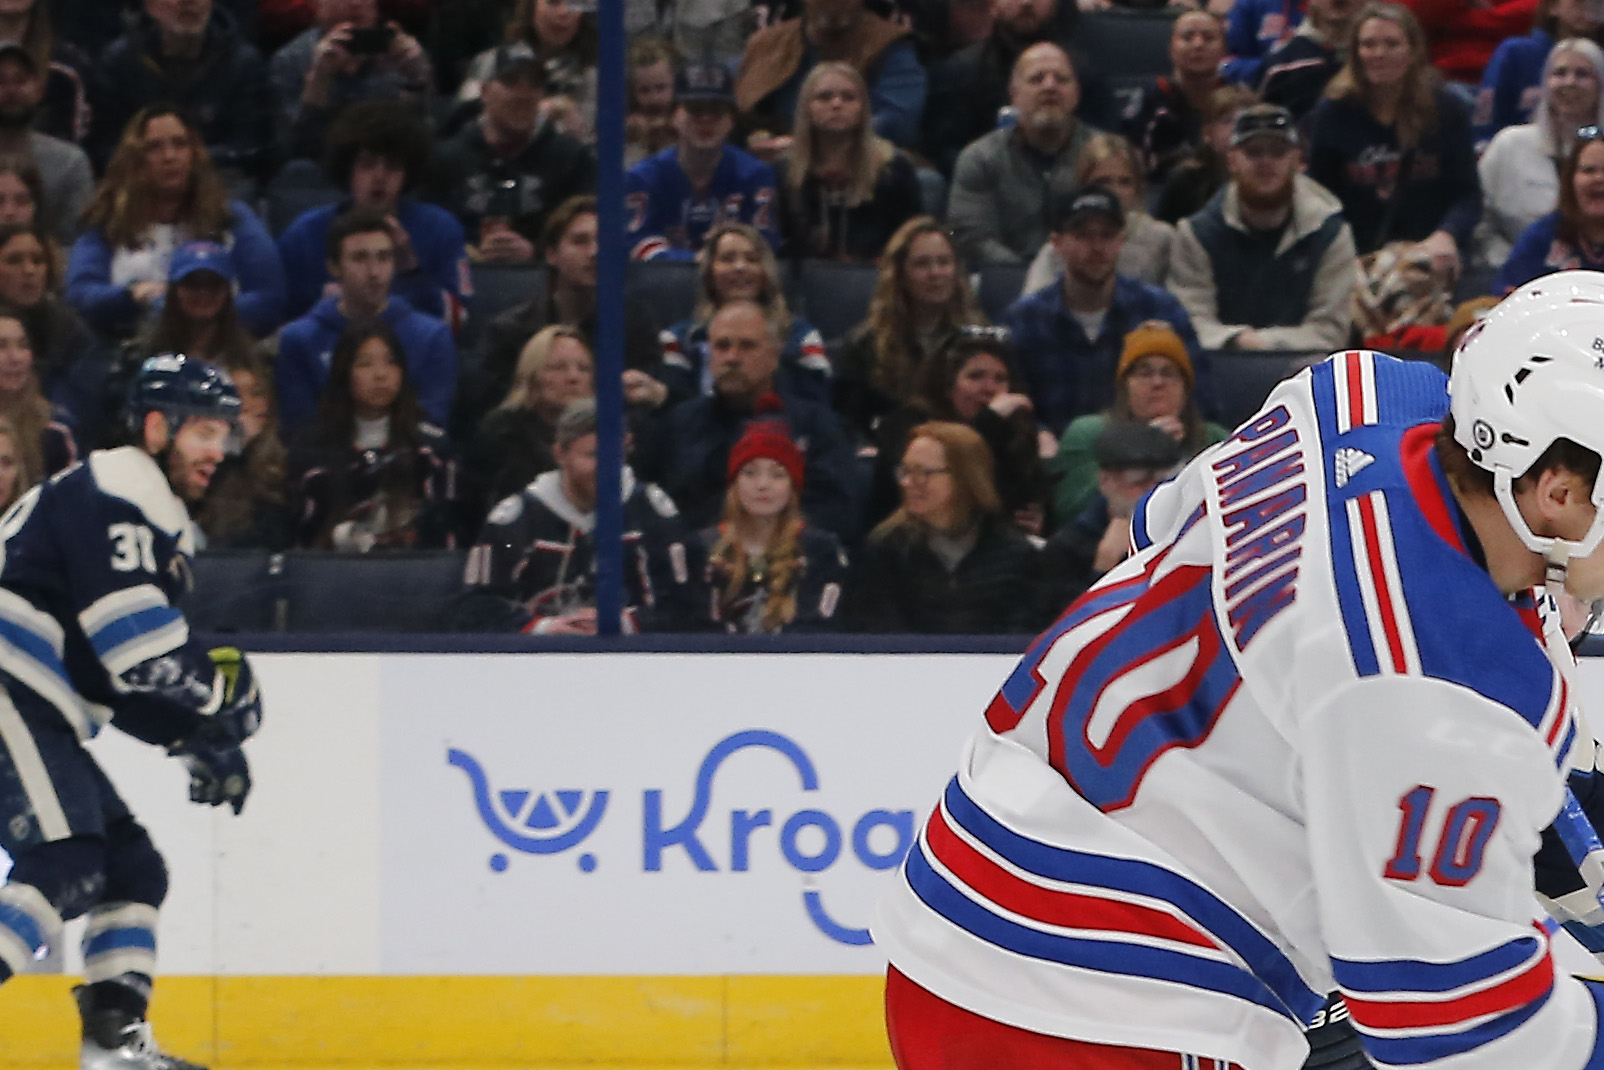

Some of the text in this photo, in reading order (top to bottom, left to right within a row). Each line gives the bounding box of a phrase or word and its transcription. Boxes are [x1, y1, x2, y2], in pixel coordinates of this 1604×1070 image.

[1211, 404, 1308, 654] PANARIN
[983, 499, 1244, 814] 10
[1383, 784, 1502, 887] 10
